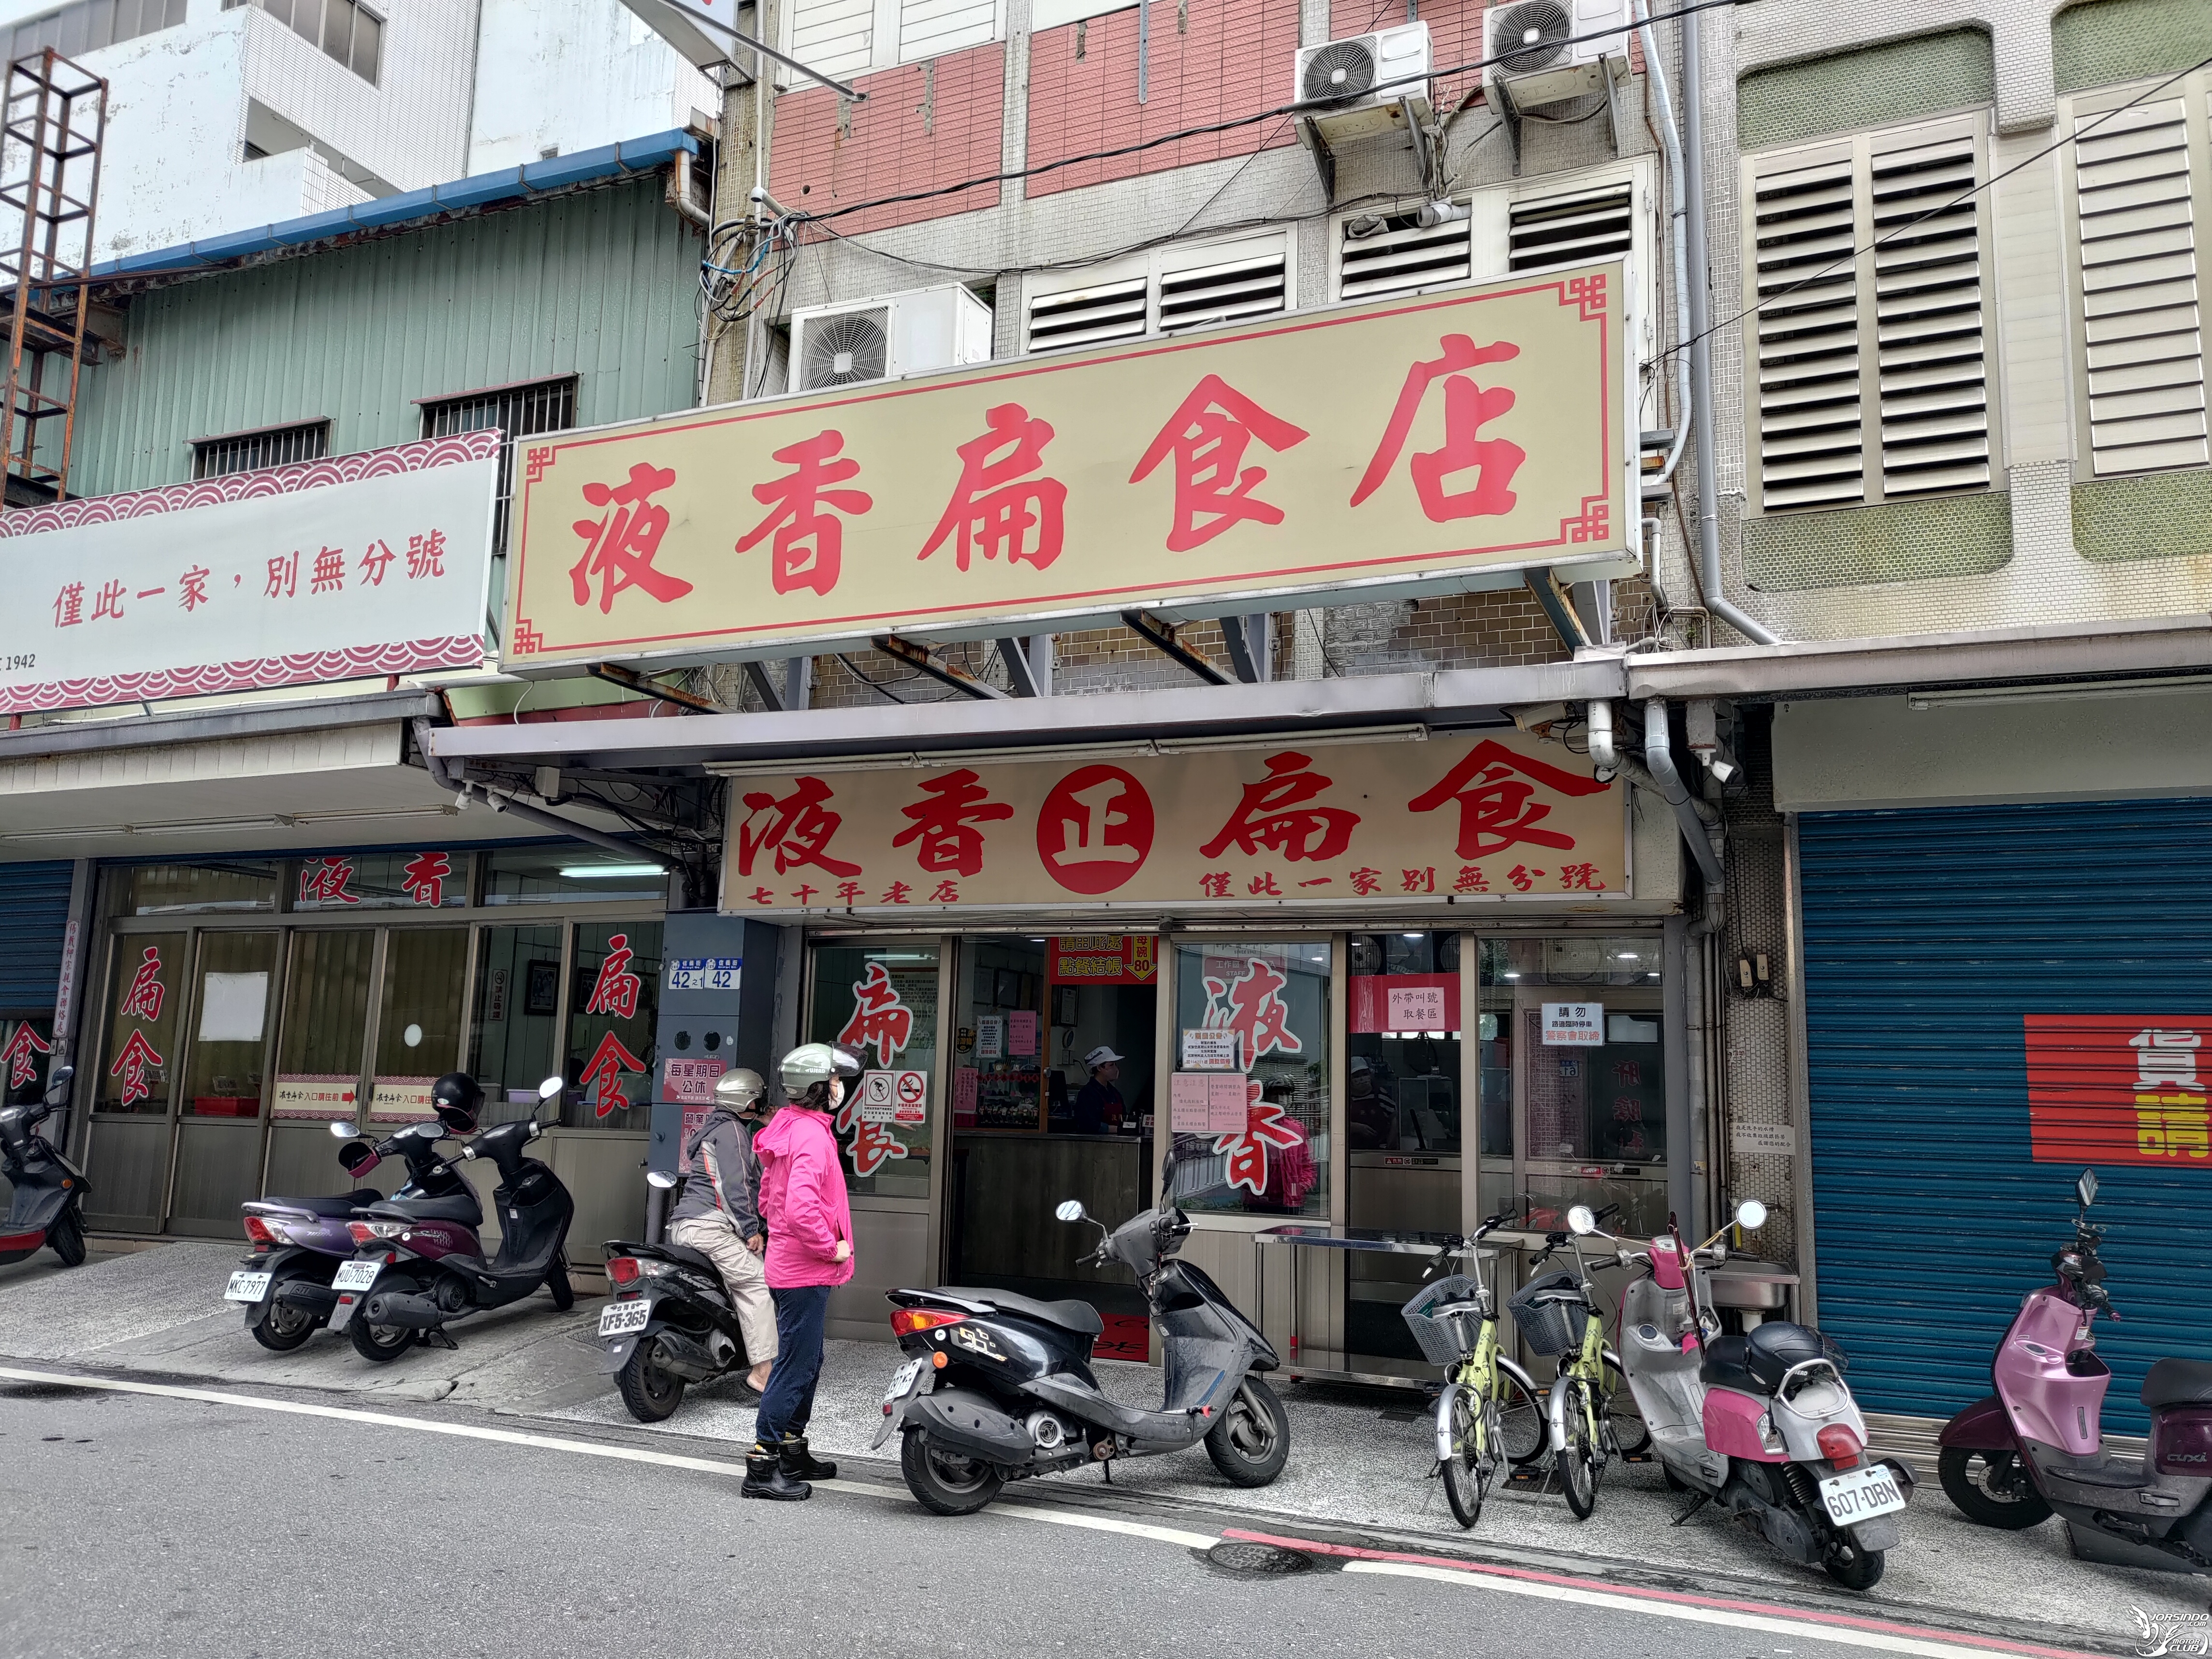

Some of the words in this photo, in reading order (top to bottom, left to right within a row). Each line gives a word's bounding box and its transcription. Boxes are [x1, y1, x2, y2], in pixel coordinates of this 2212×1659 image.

[569, 334, 1526, 614] 液香扁食店
[301, 852, 451, 907] 液香
[1199, 863, 1606, 898] 僅此一家別無分號
[748, 880, 960, 905] 七十年老店
[1059, 936, 1122, 951] 請由此處
[1059, 957, 1122, 975] 點餐結帳
[1134, 960, 1150, 972] 80
[1216, 960, 1240, 969] 工作區
[712, 971, 731, 988] 42
[1392, 992, 1438, 1004] 外帶叫號
[1403, 1008, 1437, 1019] 取餐區
[112, 946, 164, 1106] 扁食
[580, 934, 645, 1119] 扁食
[1546, 1030, 1600, 1041] 警察會取締
[1, 1021, 50, 1089] 食
[671, 1064, 720, 1078] 每星期日
[682, 1080, 706, 1093] 公休
[1827, 1480, 1900, 1517] 607-DBN
